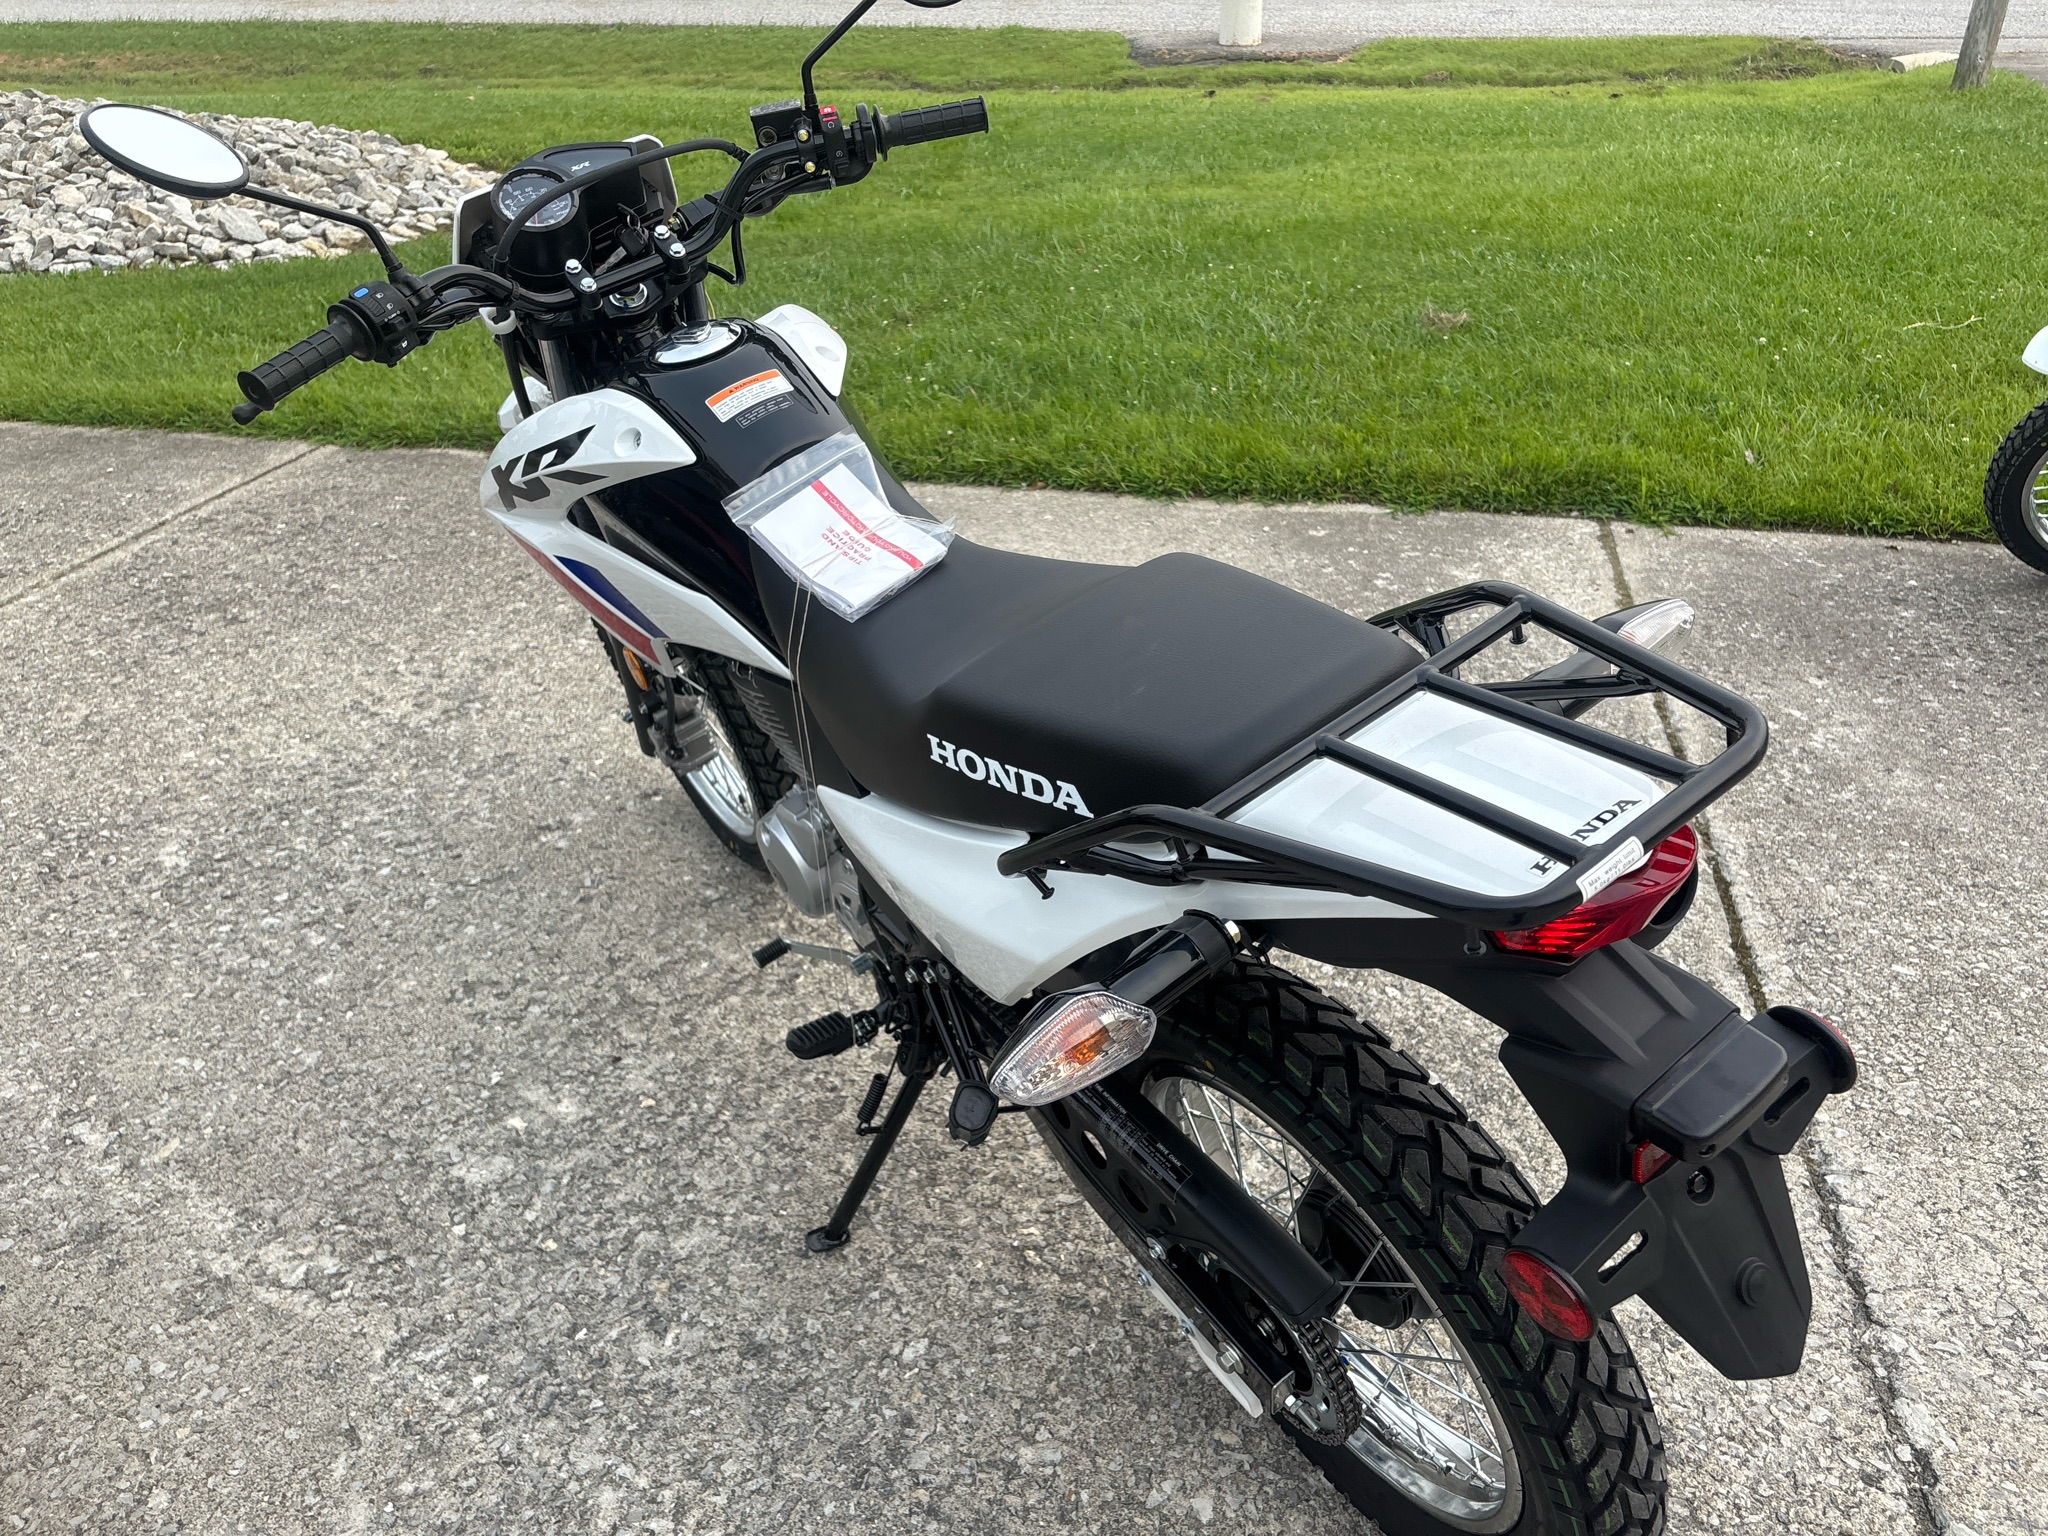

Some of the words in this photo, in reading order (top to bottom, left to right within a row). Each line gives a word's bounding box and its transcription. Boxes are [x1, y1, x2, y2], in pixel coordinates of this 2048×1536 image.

[734, 376, 759, 391] WARNING
[491, 424, 610, 512] XR
[821, 490, 866, 532] MOTORCYCLE
[821, 533, 843, 551] AND
[825, 526, 872, 562] PRACTICE
[841, 550, 862, 566] TIPS
[927, 733, 1095, 819] HONDA
[1529, 799, 1643, 876] HNDA
